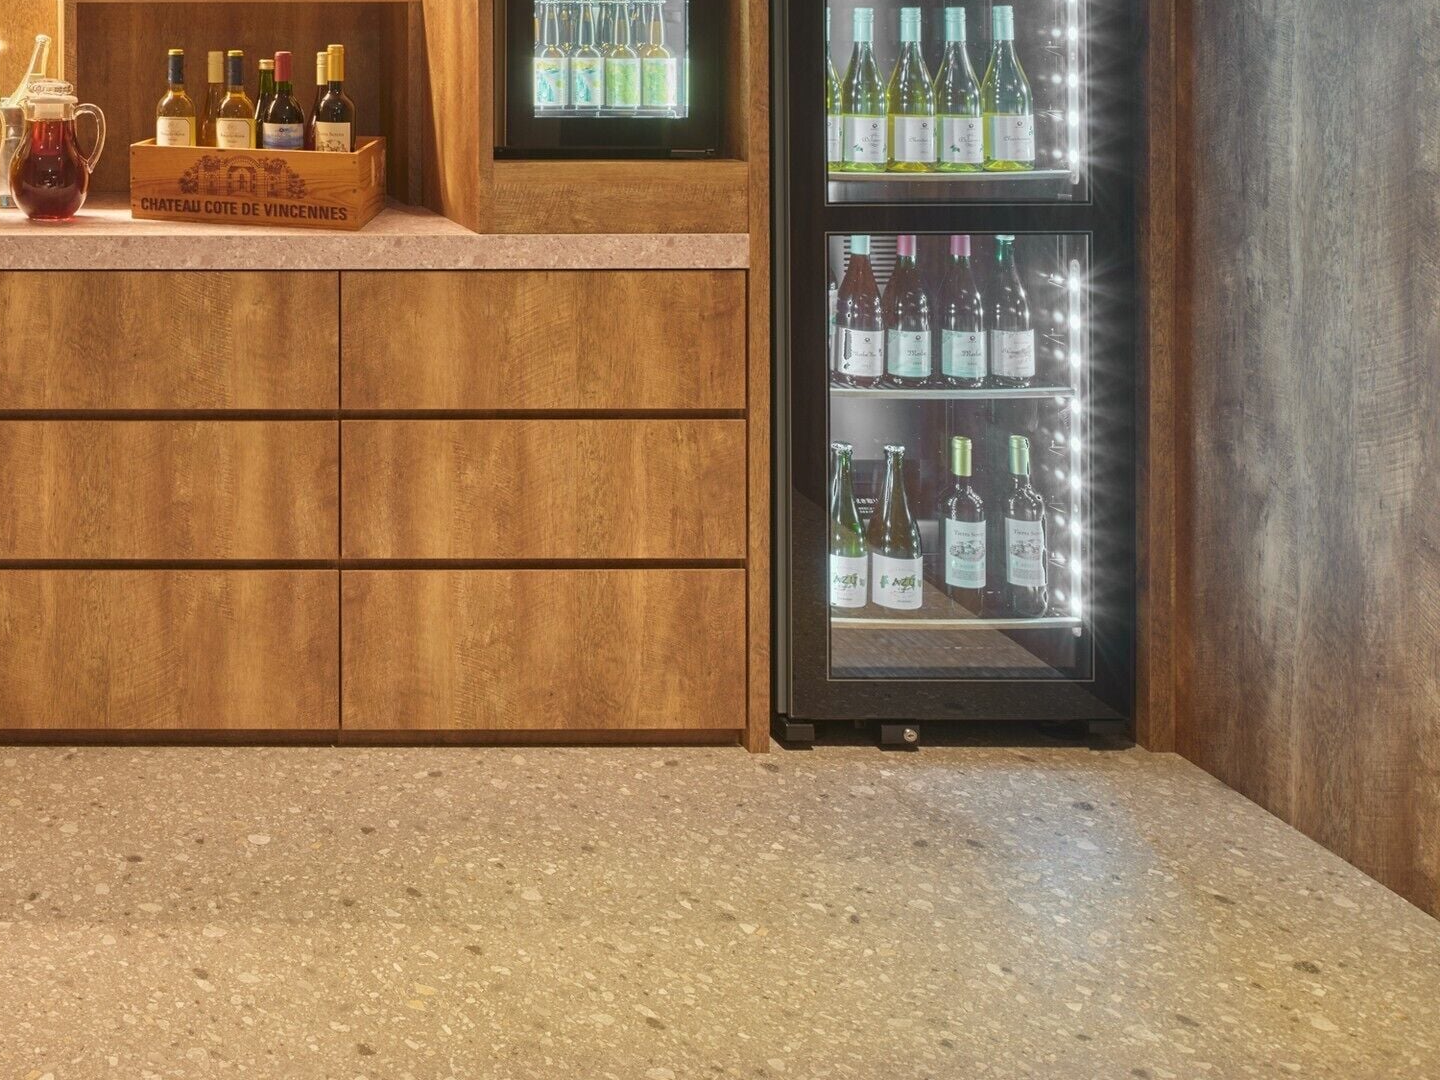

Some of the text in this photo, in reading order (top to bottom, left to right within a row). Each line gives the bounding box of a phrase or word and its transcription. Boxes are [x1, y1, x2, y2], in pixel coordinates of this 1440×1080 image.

[140, 197, 348, 221] CHATEAU COTE DE VINCENNES
